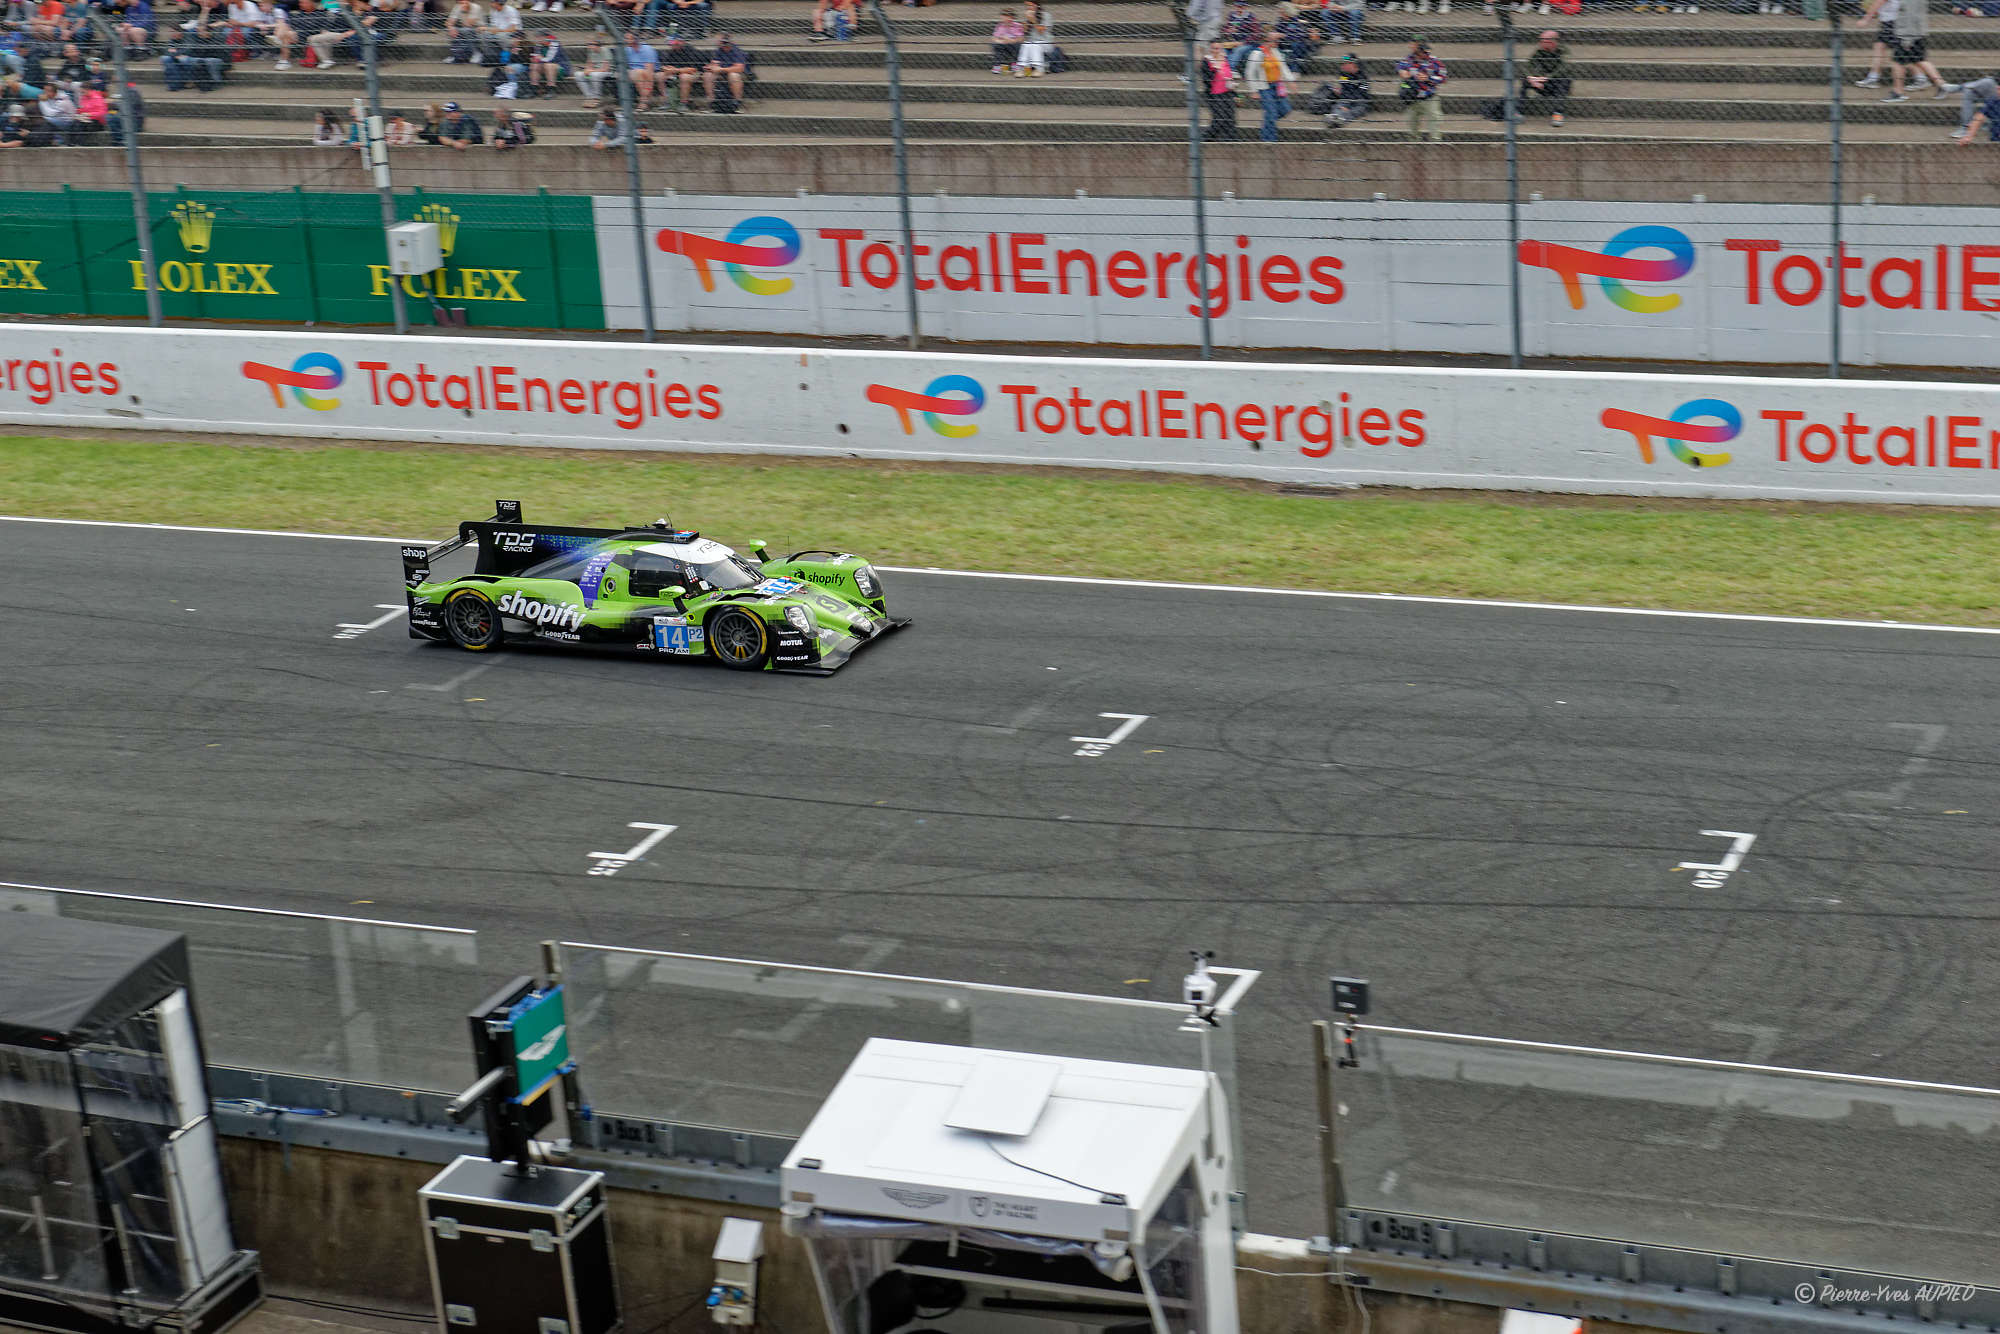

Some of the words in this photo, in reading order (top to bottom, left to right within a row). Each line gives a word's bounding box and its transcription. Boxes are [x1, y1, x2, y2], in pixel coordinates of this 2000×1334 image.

[819, 229, 1345, 319] TotalEnergies
[0, 348, 120, 405] rgies
[357, 362, 721, 431] TotalEnergies
[1000, 385, 1425, 458] TotalEnergies
[402, 548, 427, 559] shop
[493, 532, 536, 546] TDS
[808, 572, 845, 586] shopify
[498, 591, 586, 632] shopify
[658, 627, 685, 649] 14
[689, 629, 703, 640] P2
